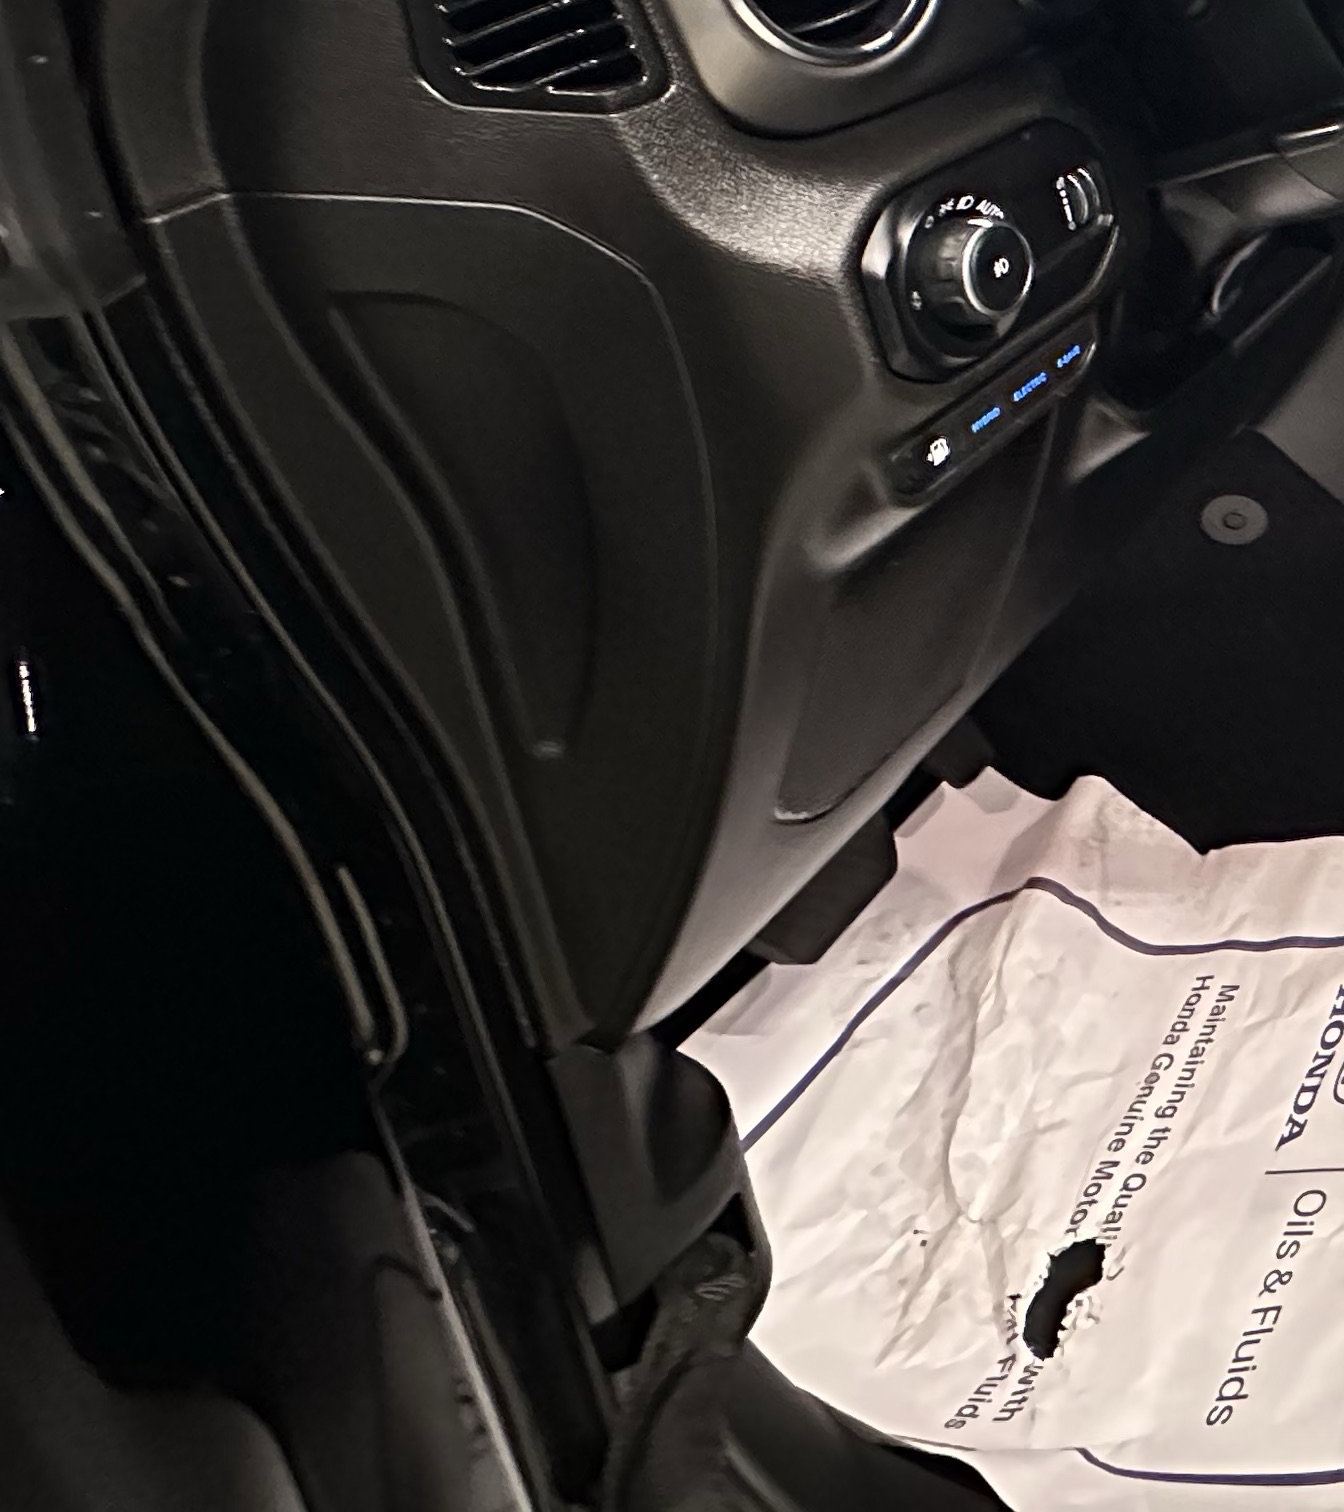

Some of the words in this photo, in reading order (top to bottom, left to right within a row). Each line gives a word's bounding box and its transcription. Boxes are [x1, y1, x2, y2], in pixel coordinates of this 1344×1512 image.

[1163, 974, 1215, 1045] Honda
[1154, 984, 1240, 1119] Maintaining
[1107, 1052, 1175, 1152] Genuine
[1135, 1126, 1171, 1165] the
[1064, 1159, 1121, 1237] Motor
[1098, 1173, 1147, 1248] Quali
[1276, 1189, 1327, 1259] Oils
[1258, 1269, 1294, 1298] &
[944, 1353, 1016, 1429] Fluids
[992, 1362, 1043, 1422] with
[1205, 1304, 1283, 1426] Fluids
